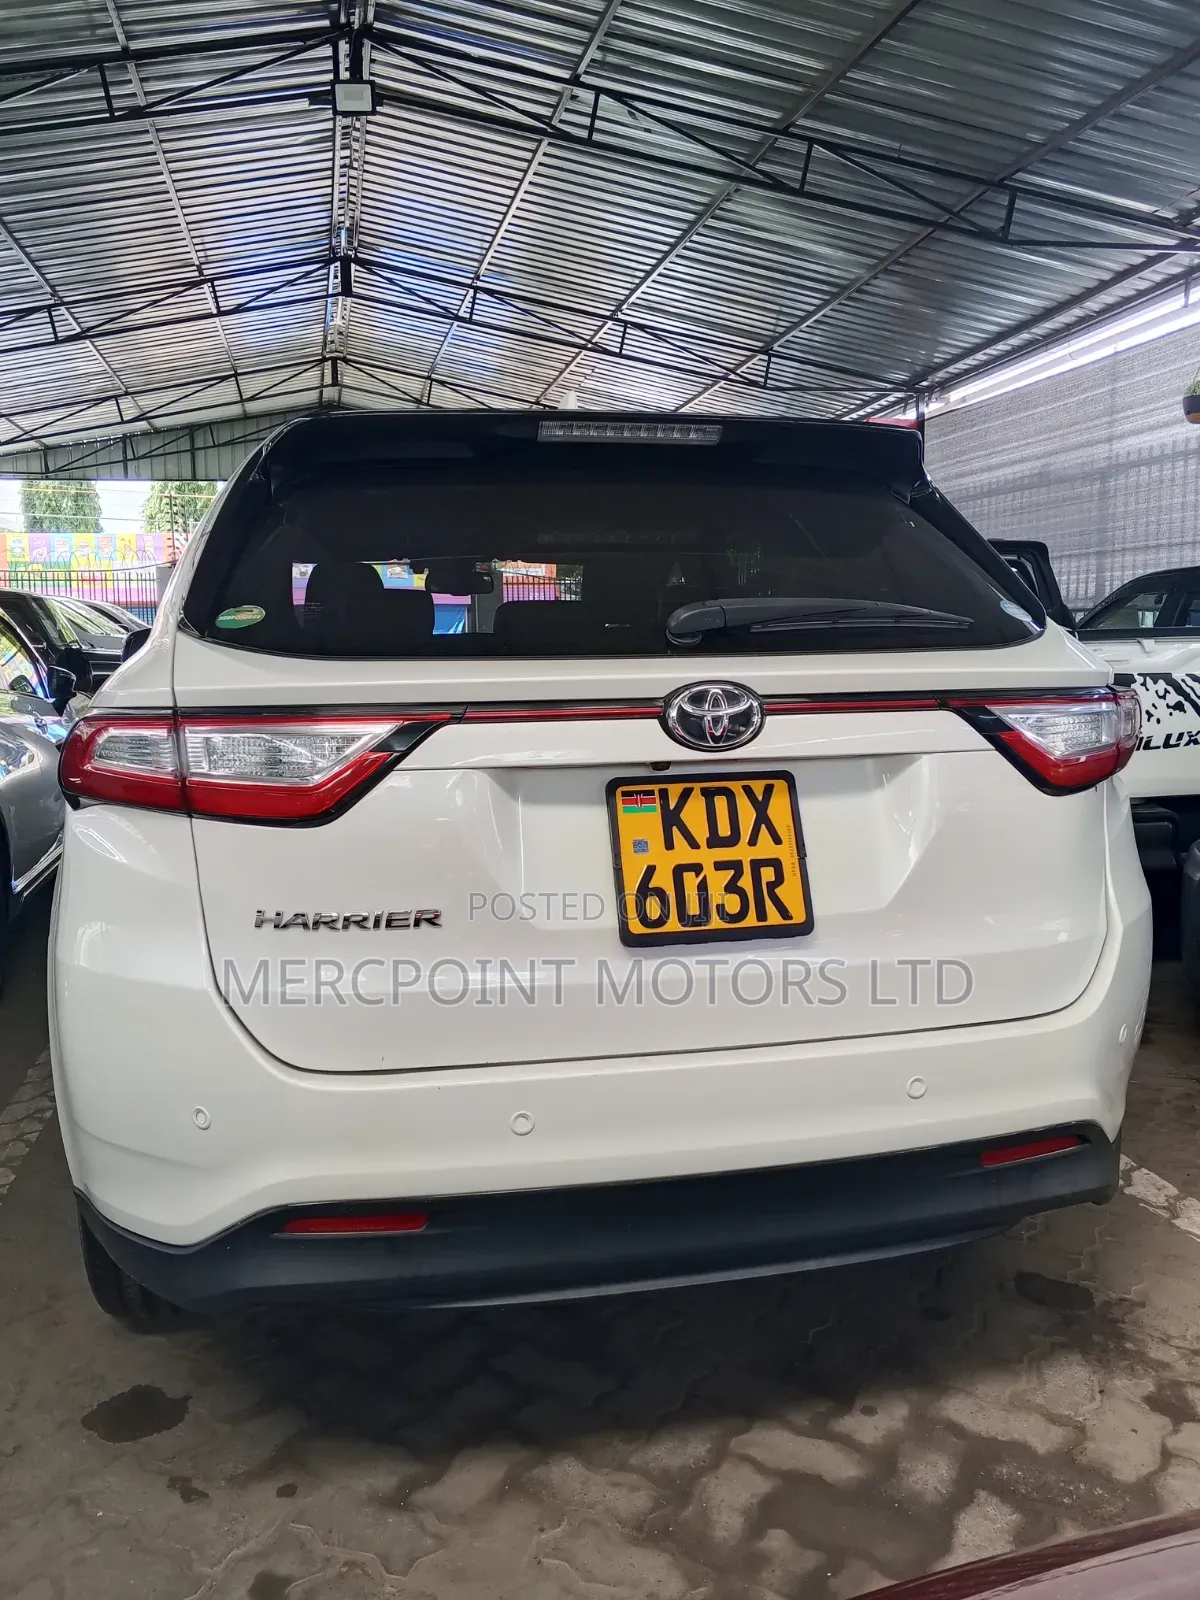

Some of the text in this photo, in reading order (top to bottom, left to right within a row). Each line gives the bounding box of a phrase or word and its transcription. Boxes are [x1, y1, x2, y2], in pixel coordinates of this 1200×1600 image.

[1135, 730, 1200, 751] ILUX
[658, 784, 783, 851] KDX
[635, 857, 794, 929] 603R
[254, 908, 443, 931] HARRIER
